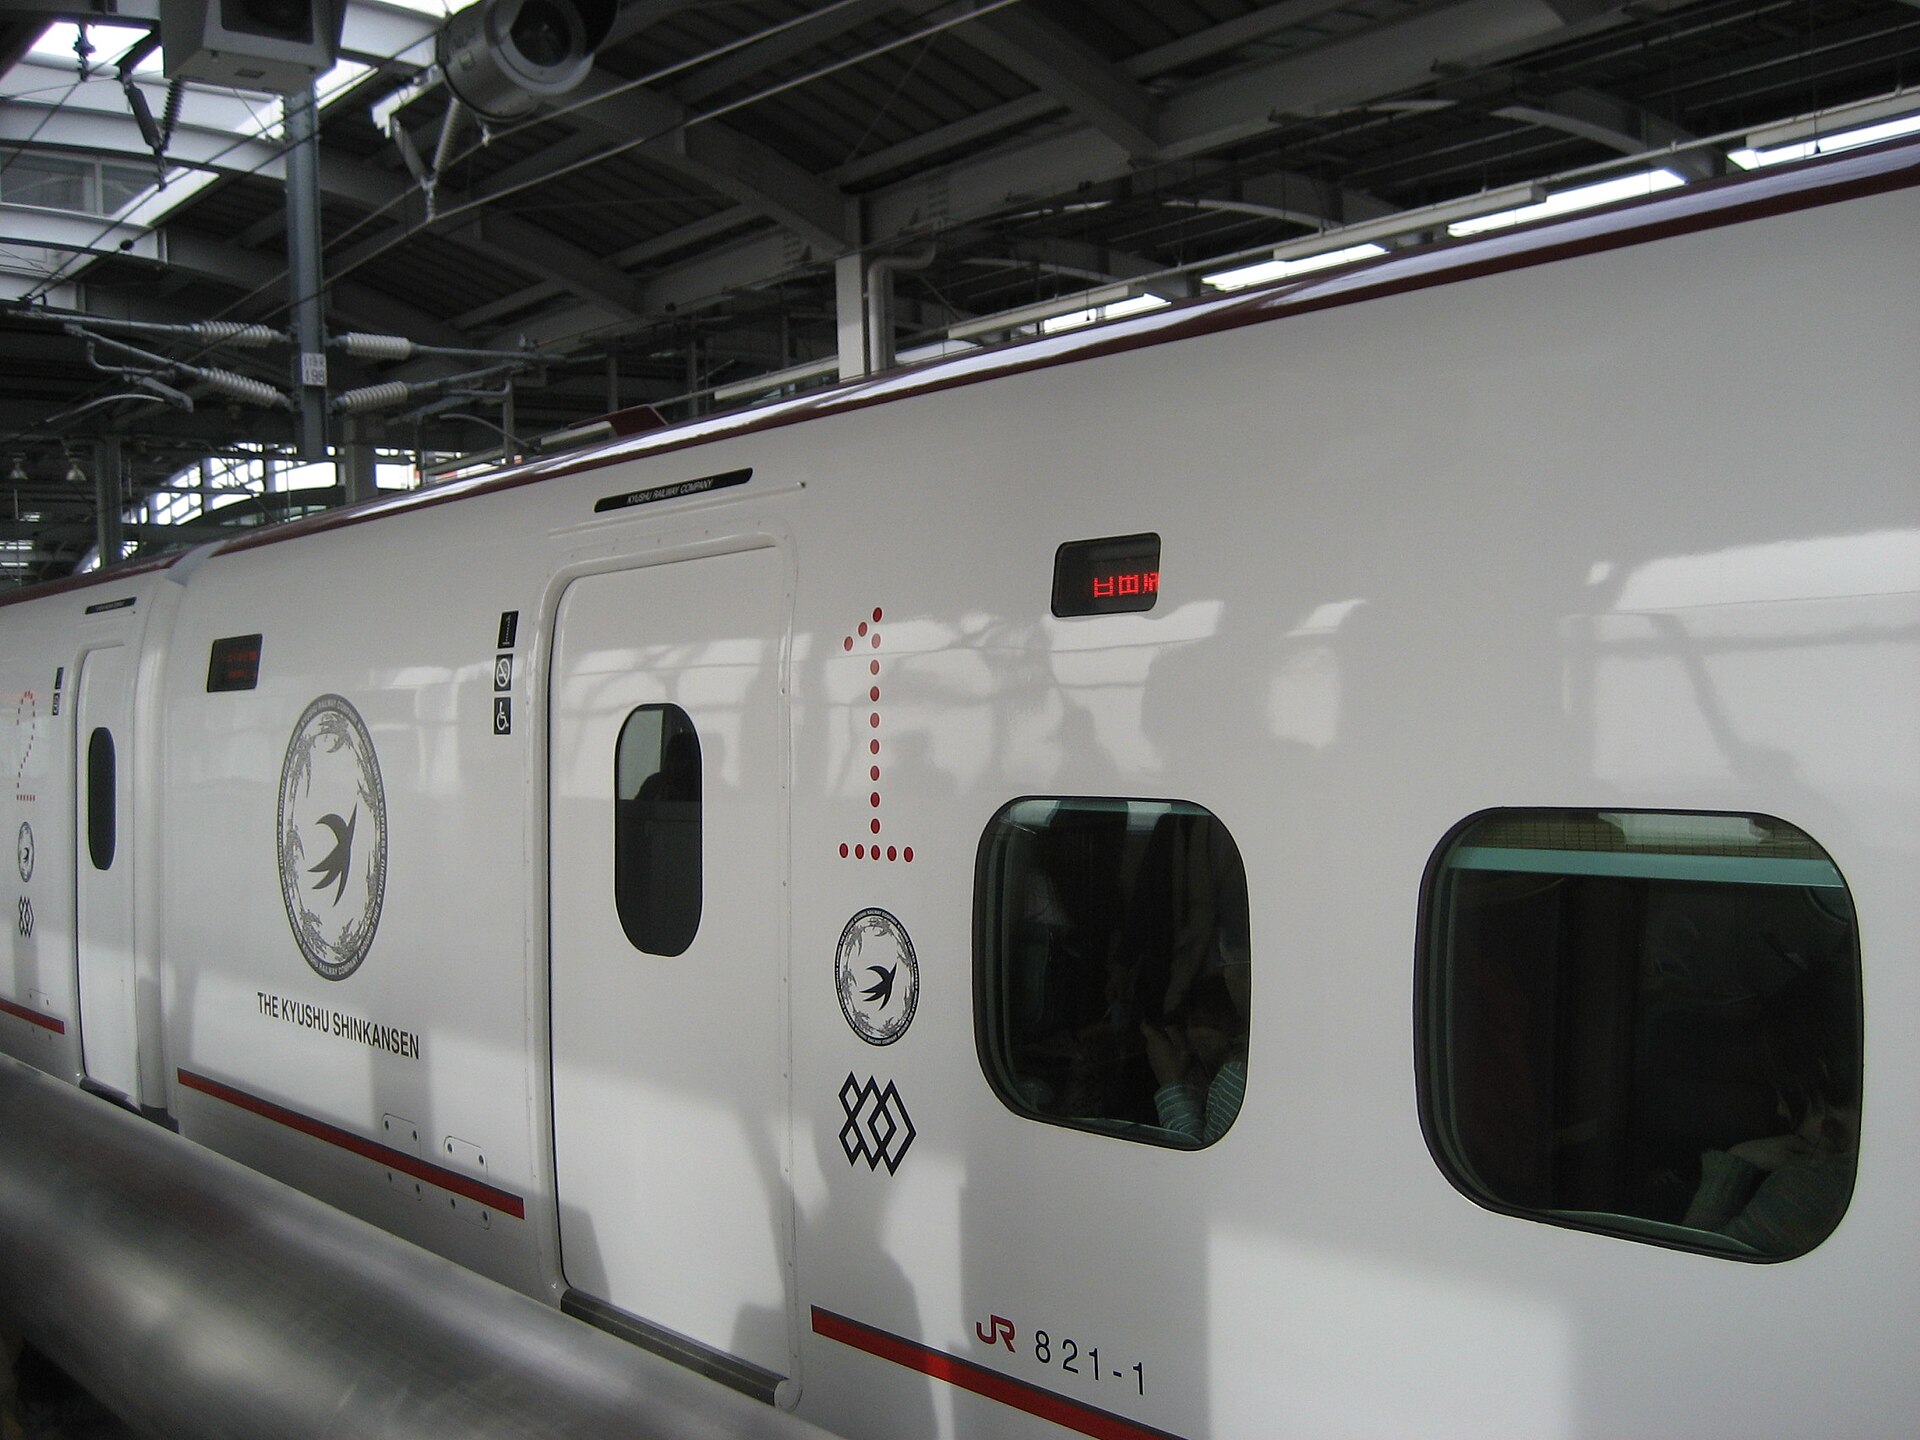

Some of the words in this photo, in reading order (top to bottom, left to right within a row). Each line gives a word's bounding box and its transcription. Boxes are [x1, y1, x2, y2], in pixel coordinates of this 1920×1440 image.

[627, 491, 652, 504] KYUSHU
[652, 486, 680, 500] RAILWAY
[679, 478, 714, 495] COMPANY
[378, 800, 386, 854] EXPRESS
[318, 960, 338, 975] RAILWAY
[338, 952, 358, 974] COMPANY
[371, 902, 379, 925] THE
[375, 857, 385, 905] KYUSHU
[257, 991, 280, 1019] THE
[281, 997, 330, 1033] KYUSHU
[332, 1011, 420, 1060] SHINKANSEN
[975, 1313, 1016, 1354] JR
[1034, 1329, 1144, 1396] 821-1
